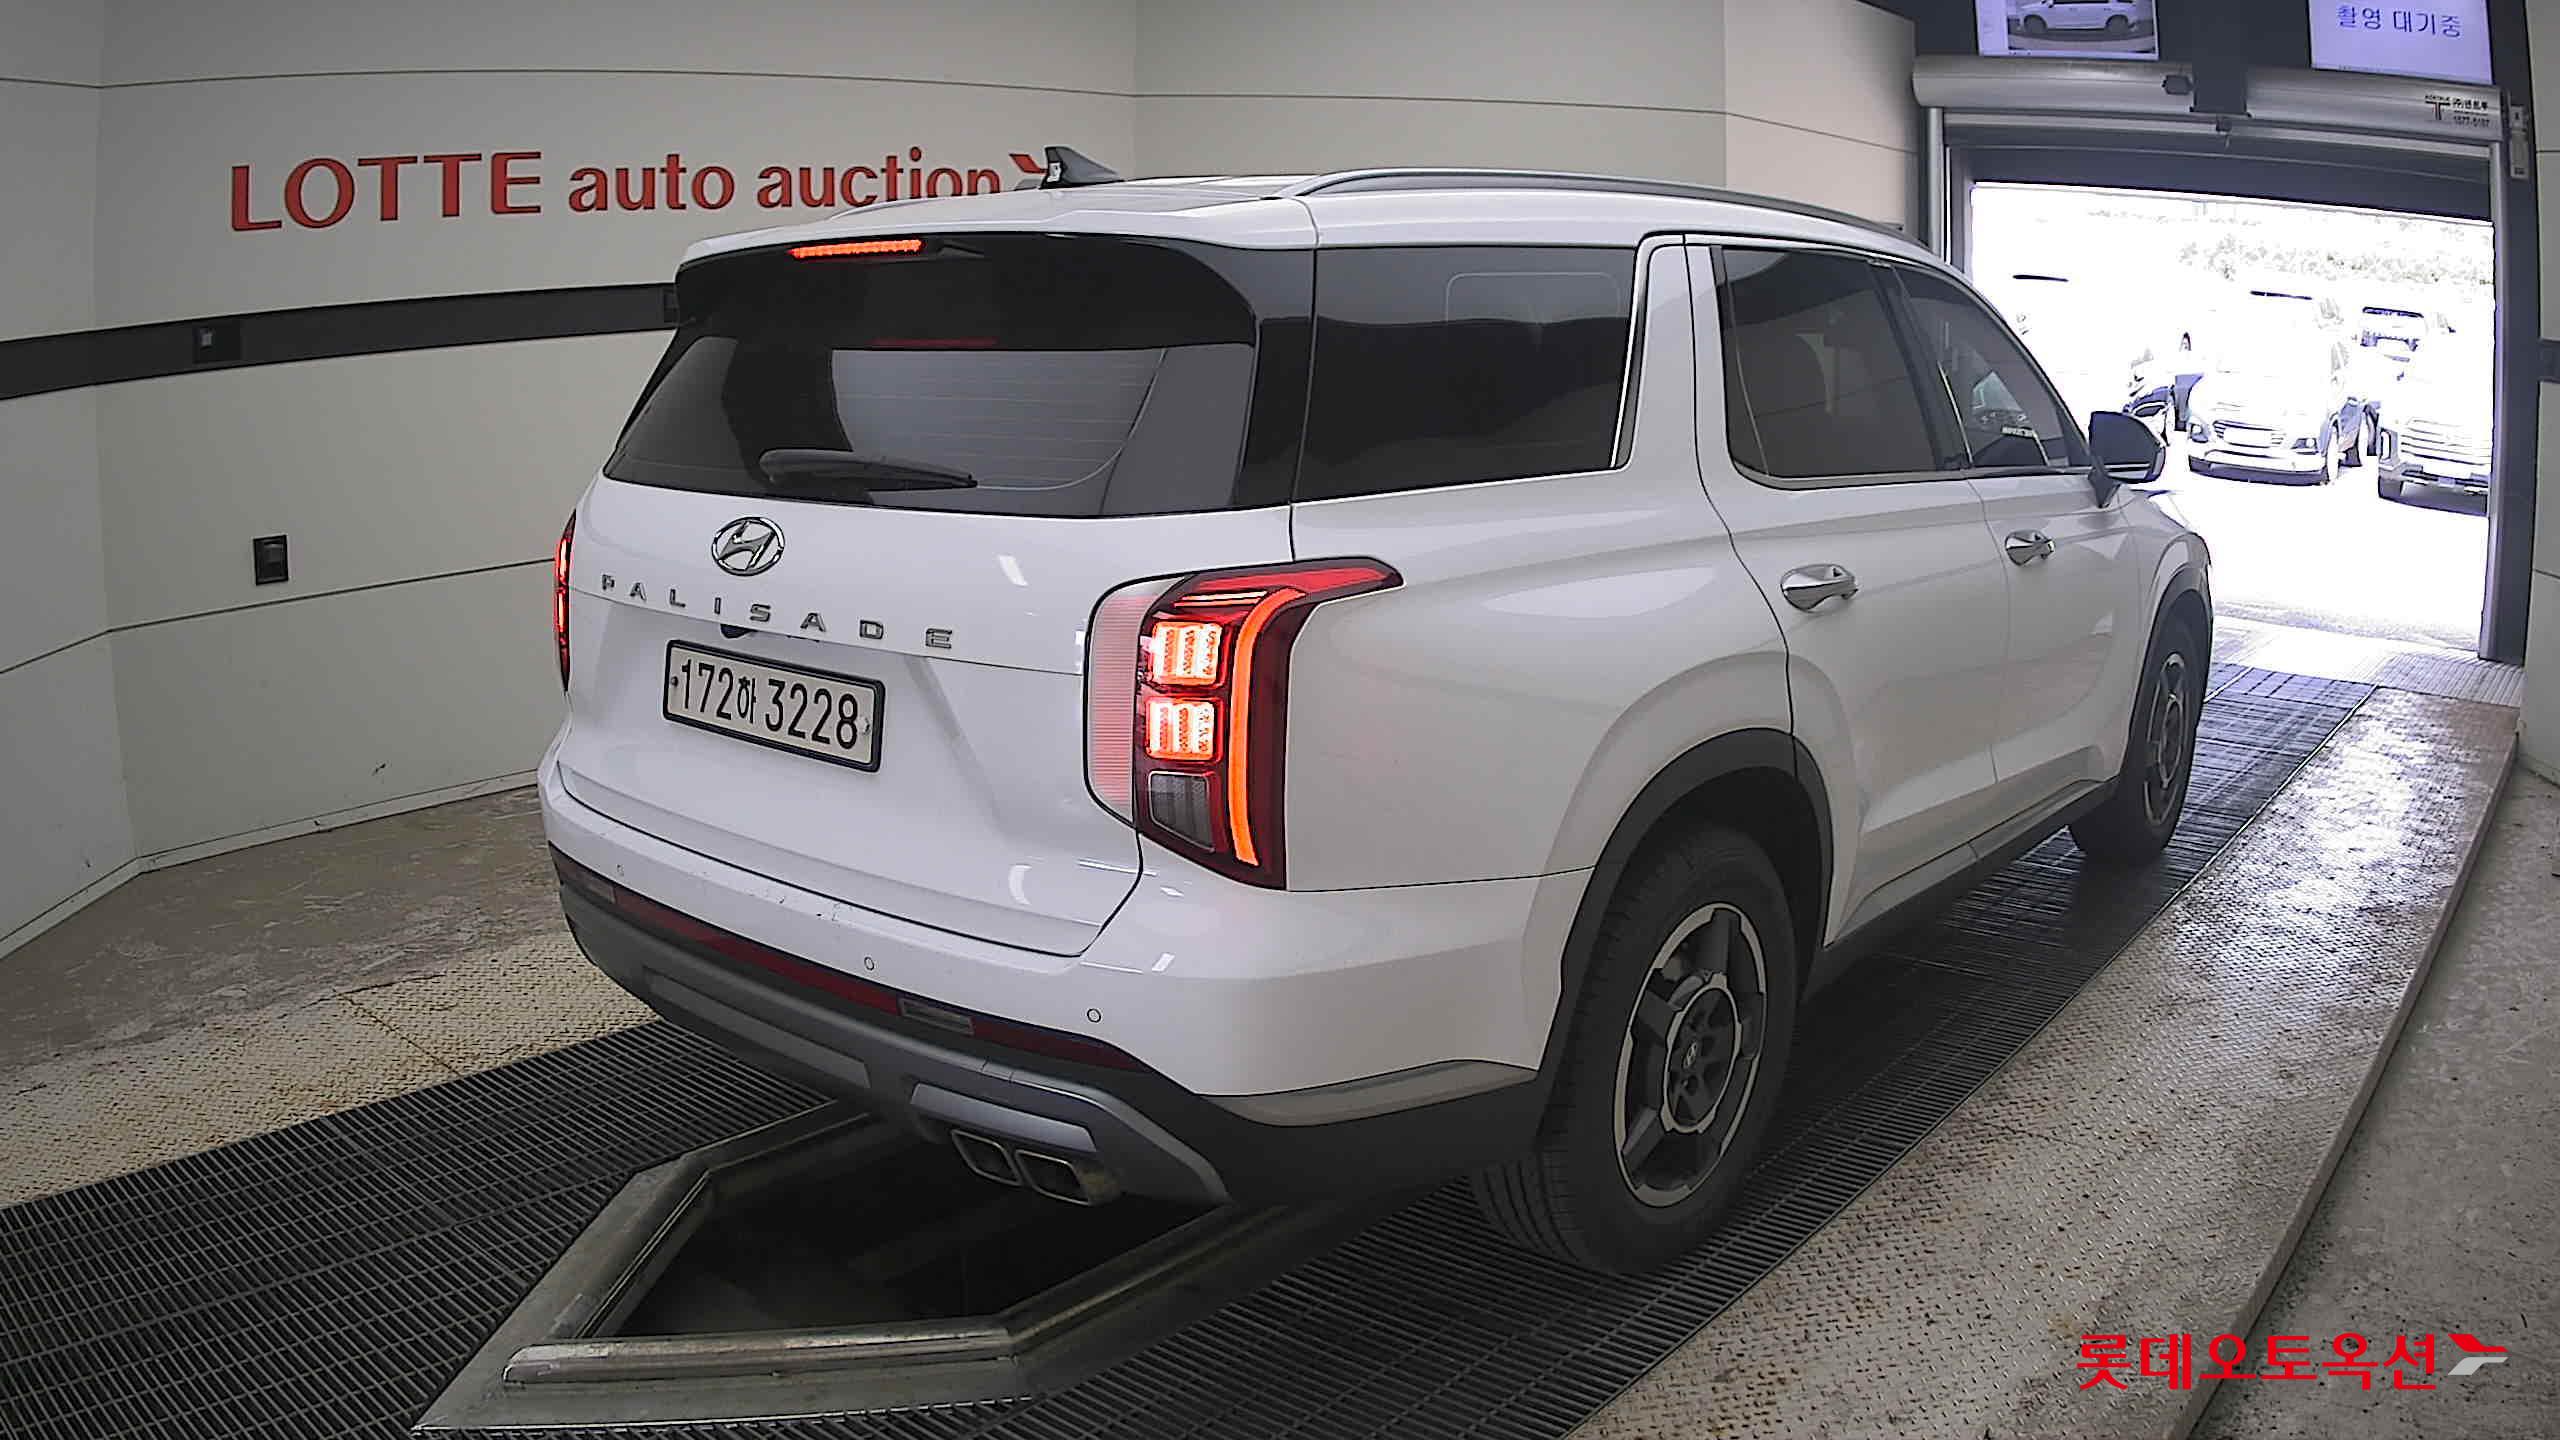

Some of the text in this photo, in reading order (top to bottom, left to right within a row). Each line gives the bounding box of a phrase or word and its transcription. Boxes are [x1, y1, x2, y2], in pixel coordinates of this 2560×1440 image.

[2393, 11, 2461, 38] 대기중
[231, 146, 1001, 232] LOTTE auto auction
[600, 573, 953, 650] PALISADE
